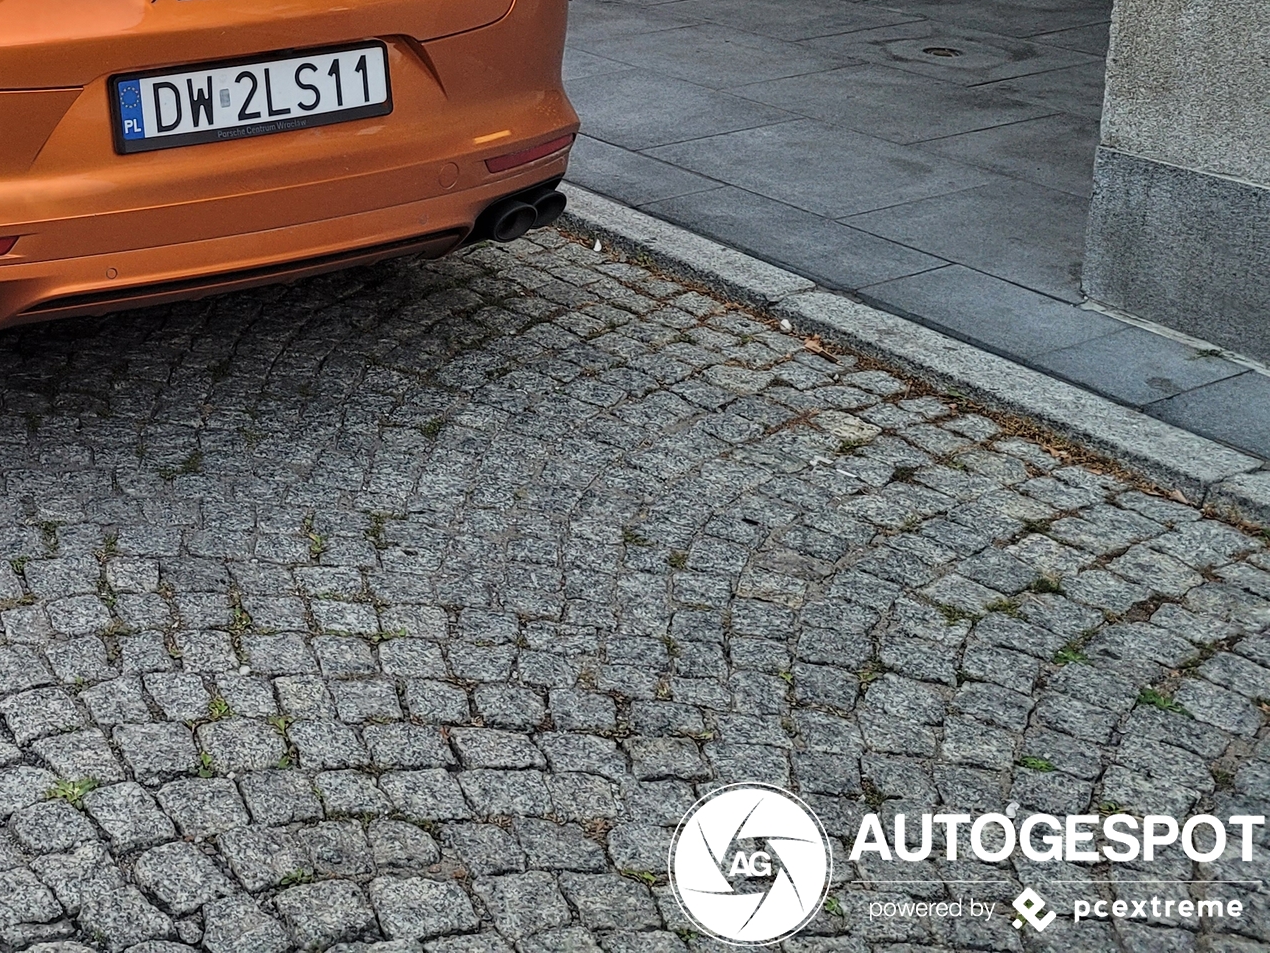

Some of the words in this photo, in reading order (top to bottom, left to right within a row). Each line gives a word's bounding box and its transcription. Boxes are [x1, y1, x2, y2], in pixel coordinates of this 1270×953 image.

[152, 75, 215, 133] DW
[234, 54, 371, 121] 2LS11
[124, 118, 142, 134] PL
[217, 128, 246, 139] Porsche
[246, 124, 276, 134] Centrum
